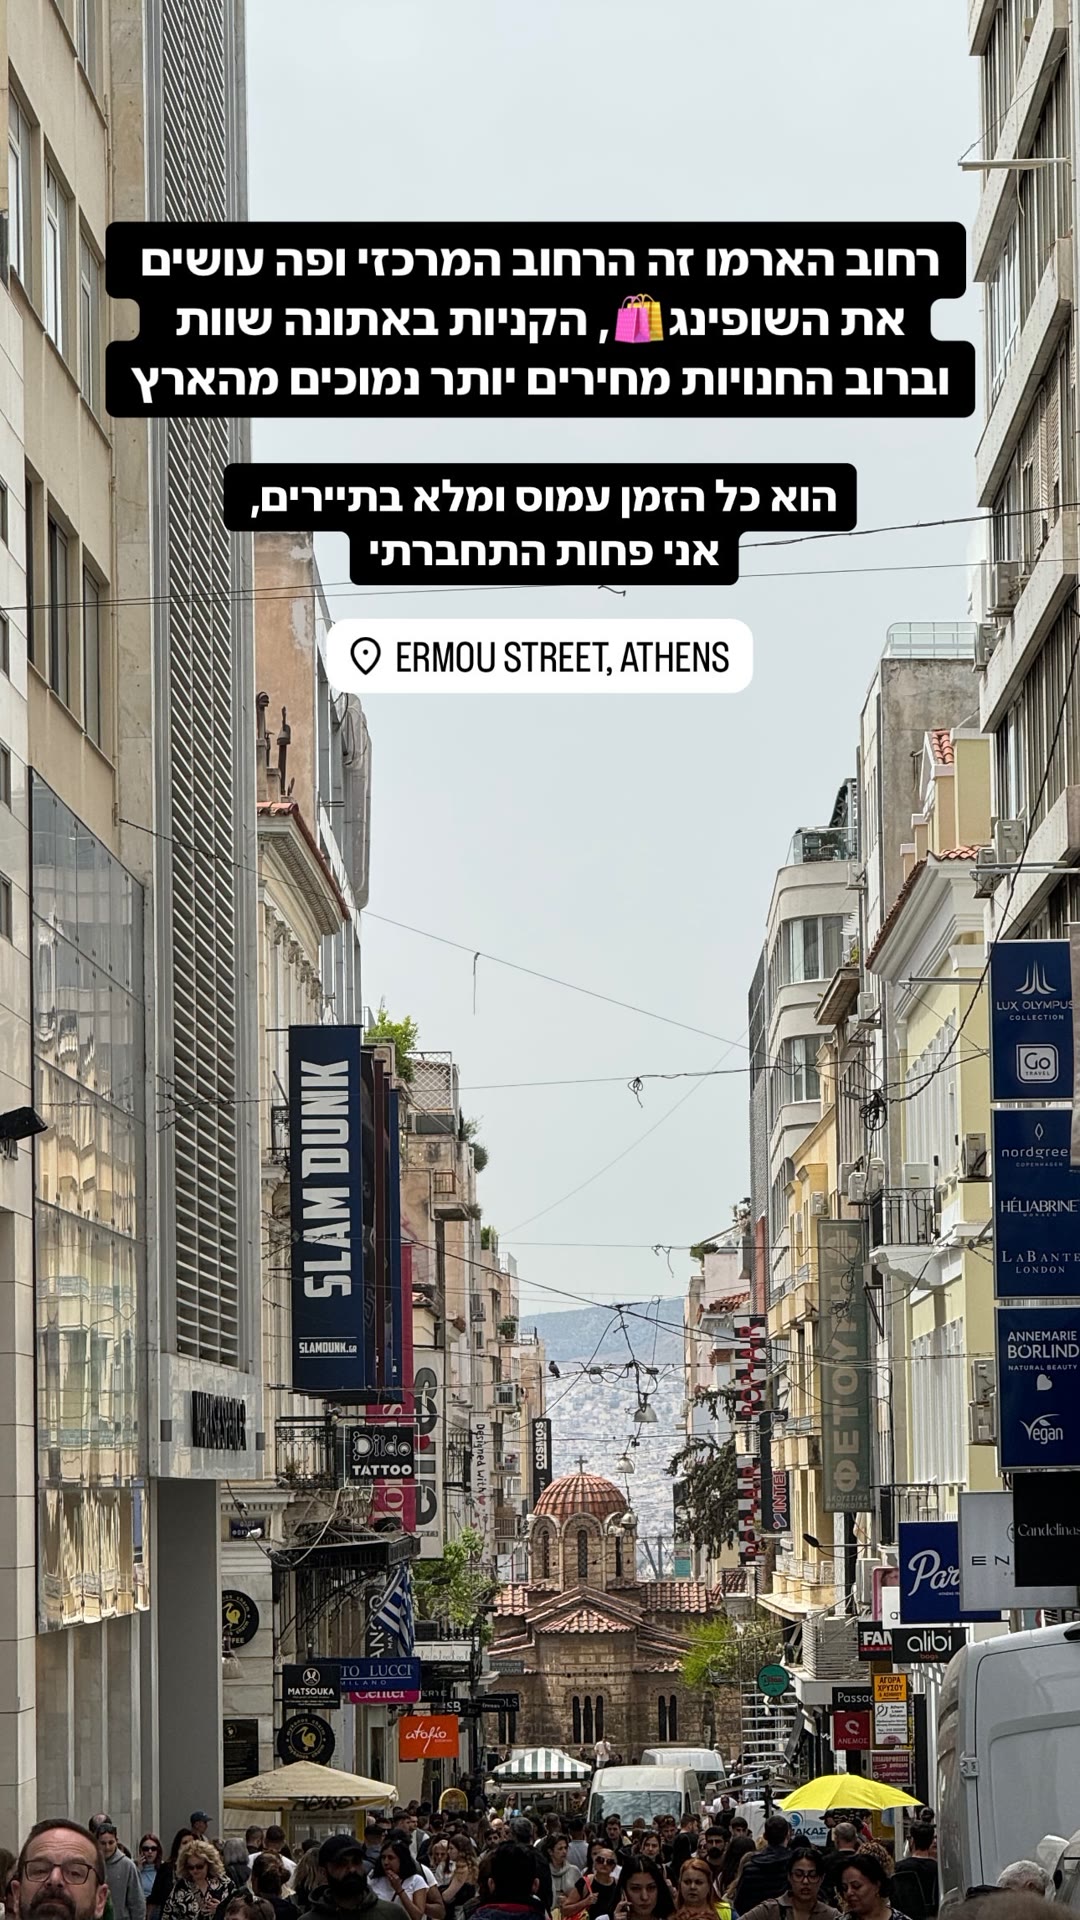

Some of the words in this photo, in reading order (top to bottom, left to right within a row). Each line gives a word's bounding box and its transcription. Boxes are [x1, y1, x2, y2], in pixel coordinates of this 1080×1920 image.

[997, 1001, 1019, 1012] LUX
[1023, 1000, 1074, 1010] OLYMPUS
[1024, 1052, 1051, 1070] Go
[301, 1060, 349, 1179] DUNK
[1002, 1147, 1068, 1159] nordgree
[1000, 1197, 1078, 1213] HÉLIABRINE
[303, 1188, 351, 1298] SLAM
[1015, 1266, 1065, 1274] LONDON
[1007, 1331, 1077, 1342] ANNEMARIE
[299, 1342, 357, 1353] SLAMDUNK.GR
[1008, 1344, 1080, 1359] BÖRLIND
[1019, 1413, 1063, 1445] Vegan
[535, 1421, 545, 1470] COSMOS
[352, 1465, 412, 1476] TATTOO
[907, 1630, 952, 1652] alibi
[920, 1653, 938, 1661] bags
[370, 1664, 411, 1676] LUCCI
[880, 1676, 901, 1684] ΑΓΟΡΑ
[792, 1827, 827, 1835] ΑΚΑΣ
